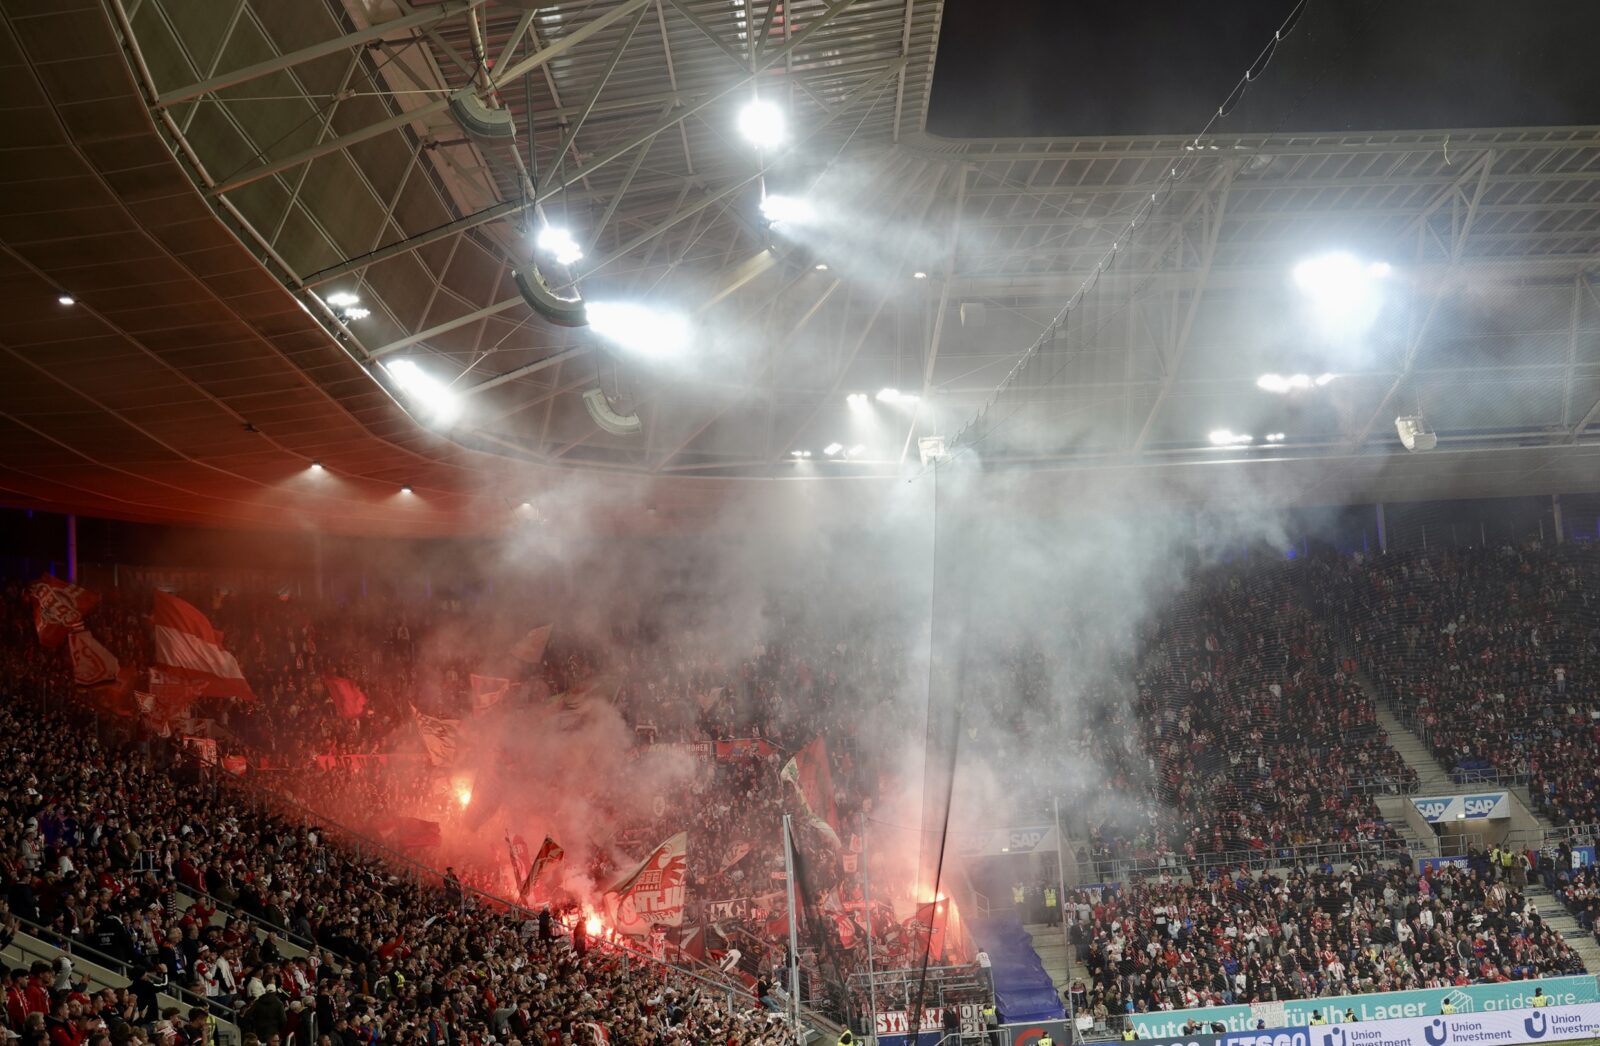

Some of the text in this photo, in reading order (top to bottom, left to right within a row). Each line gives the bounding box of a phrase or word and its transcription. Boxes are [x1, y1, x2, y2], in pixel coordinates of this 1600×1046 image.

[1416, 802, 1445, 818] SAP
[1465, 799, 1494, 815] SAP
[1010, 832, 1040, 849] SAP
[1483, 991, 1576, 1011] gridsore
[1322, 1004, 1345, 1025] Ih
[1361, 1001, 1427, 1022] Lager
[1551, 1013, 1582, 1024] Union
[1451, 1020, 1482, 1032] Union
[1351, 1029, 1382, 1041] Union
[1452, 1029, 1512, 1043] Investment
